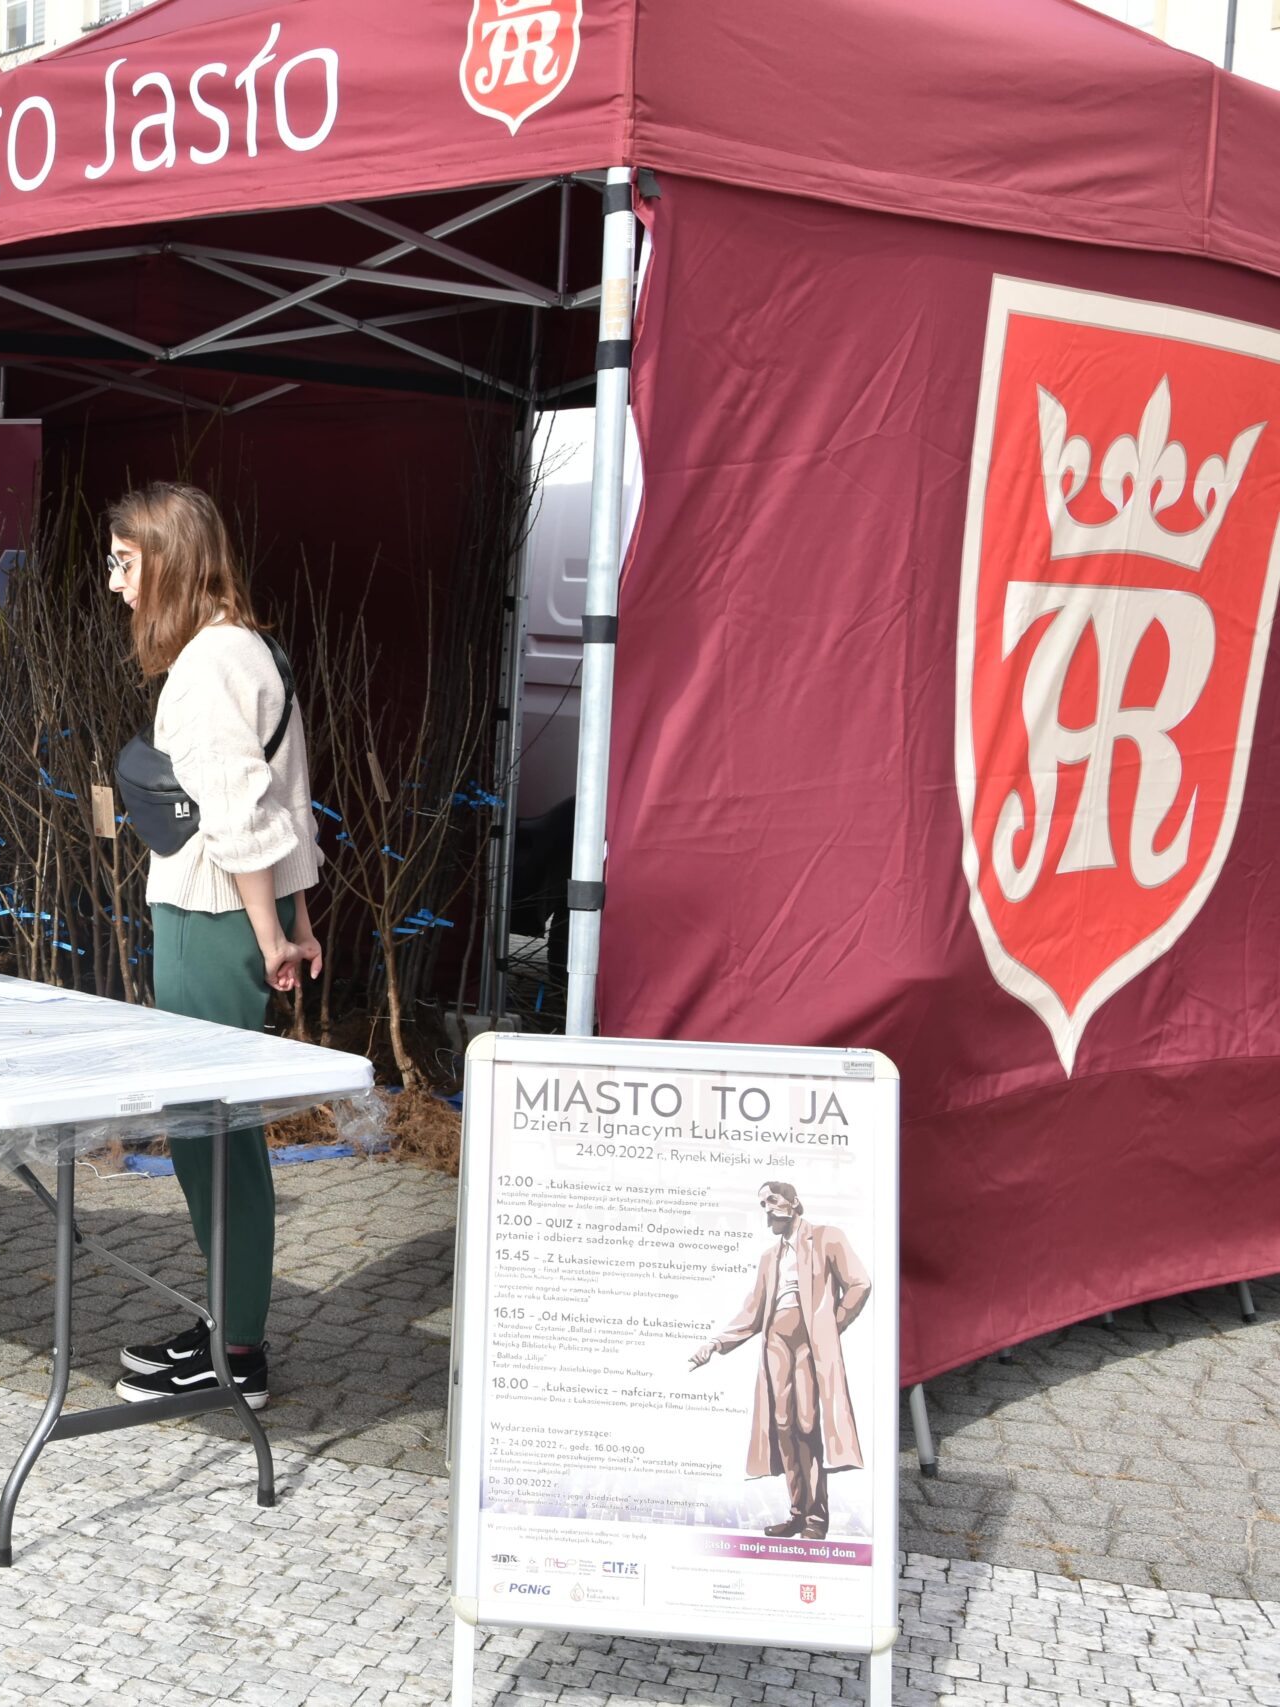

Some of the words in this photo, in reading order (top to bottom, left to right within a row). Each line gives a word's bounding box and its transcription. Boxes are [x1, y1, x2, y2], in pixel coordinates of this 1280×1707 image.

[84, 22, 340, 181] Jasło
[515, 1076, 682, 1118] MIASTO
[513, 1111, 571, 1132] Dzień
[596, 1114, 682, 1140] Ignacym
[688, 1119, 849, 1146] Łukasiewiczem
[575, 1142, 654, 1160] 24.09.2022
[656, 1152, 667, 1161] r.,
[670, 1148, 707, 1163] Rynek
[709, 1151, 751, 1166] Miejski
[765, 1153, 795, 1167] Jaśle
[495, 1213, 533, 1227] 12.00
[544, 1217, 573, 1229] QUIZ
[584, 1221, 643, 1233] nagrodami!
[646, 1222, 704, 1236] Odpowiedz
[723, 1230, 753, 1239] nasze
[495, 1231, 534, 1241] pytanie
[543, 1231, 583, 1243] odbierz
[585, 1234, 634, 1248] sadzonkę
[637, 1236, 675, 1248] drzewa
[677, 1241, 739, 1254] owocowego!
[490, 1420, 545, 1433] Wydarzenia
[547, 1426, 612, 1439] towarzyszące:
[739, 1542, 765, 1553] moje
[768, 1543, 806, 1556] miasto,
[809, 1545, 829, 1557] mój
[832, 1547, 855, 1558] dom
[508, 1582, 550, 1595] PGNiG
